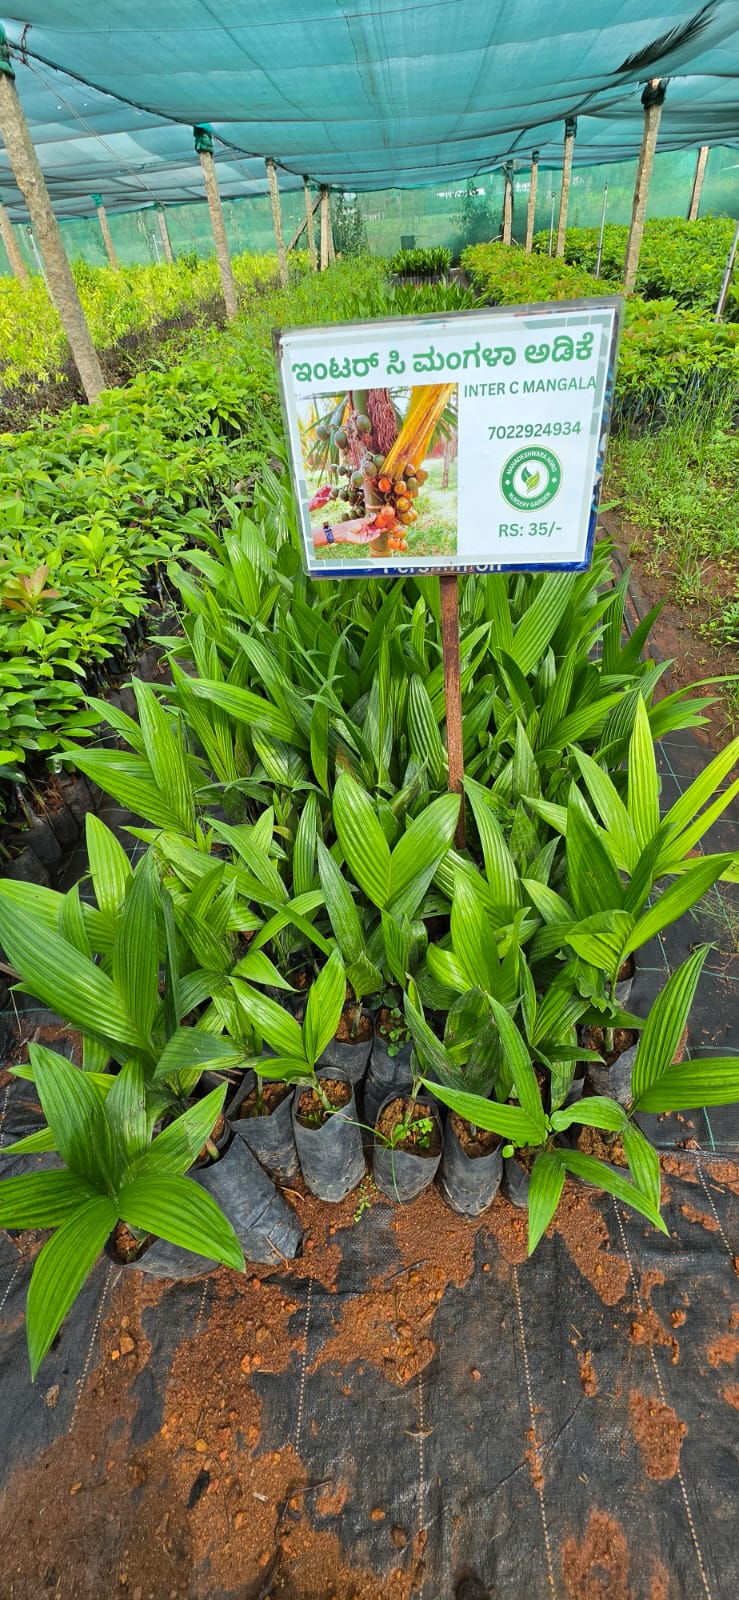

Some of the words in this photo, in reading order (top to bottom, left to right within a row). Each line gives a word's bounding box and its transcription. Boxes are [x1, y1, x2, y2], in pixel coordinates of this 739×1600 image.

[291, 351, 379, 382] ಇಂಟರ್
[386, 350, 405, 375] ಸಿ
[413, 341, 516, 373] ಮಂಗಳಾ
[524, 331, 594, 363] ಅಡಿಕೆ
[464, 382, 505, 398] INTER
[509, 381, 519, 394] C
[522, 376, 597, 394] MANGALA
[488, 421, 581, 440] 7022924934
[508, 492, 529, 507] NURSERY
[530, 492, 551, 507] GARDEN
[498, 523, 524, 537] RS:
[528, 521, 562, 537] 35/-
